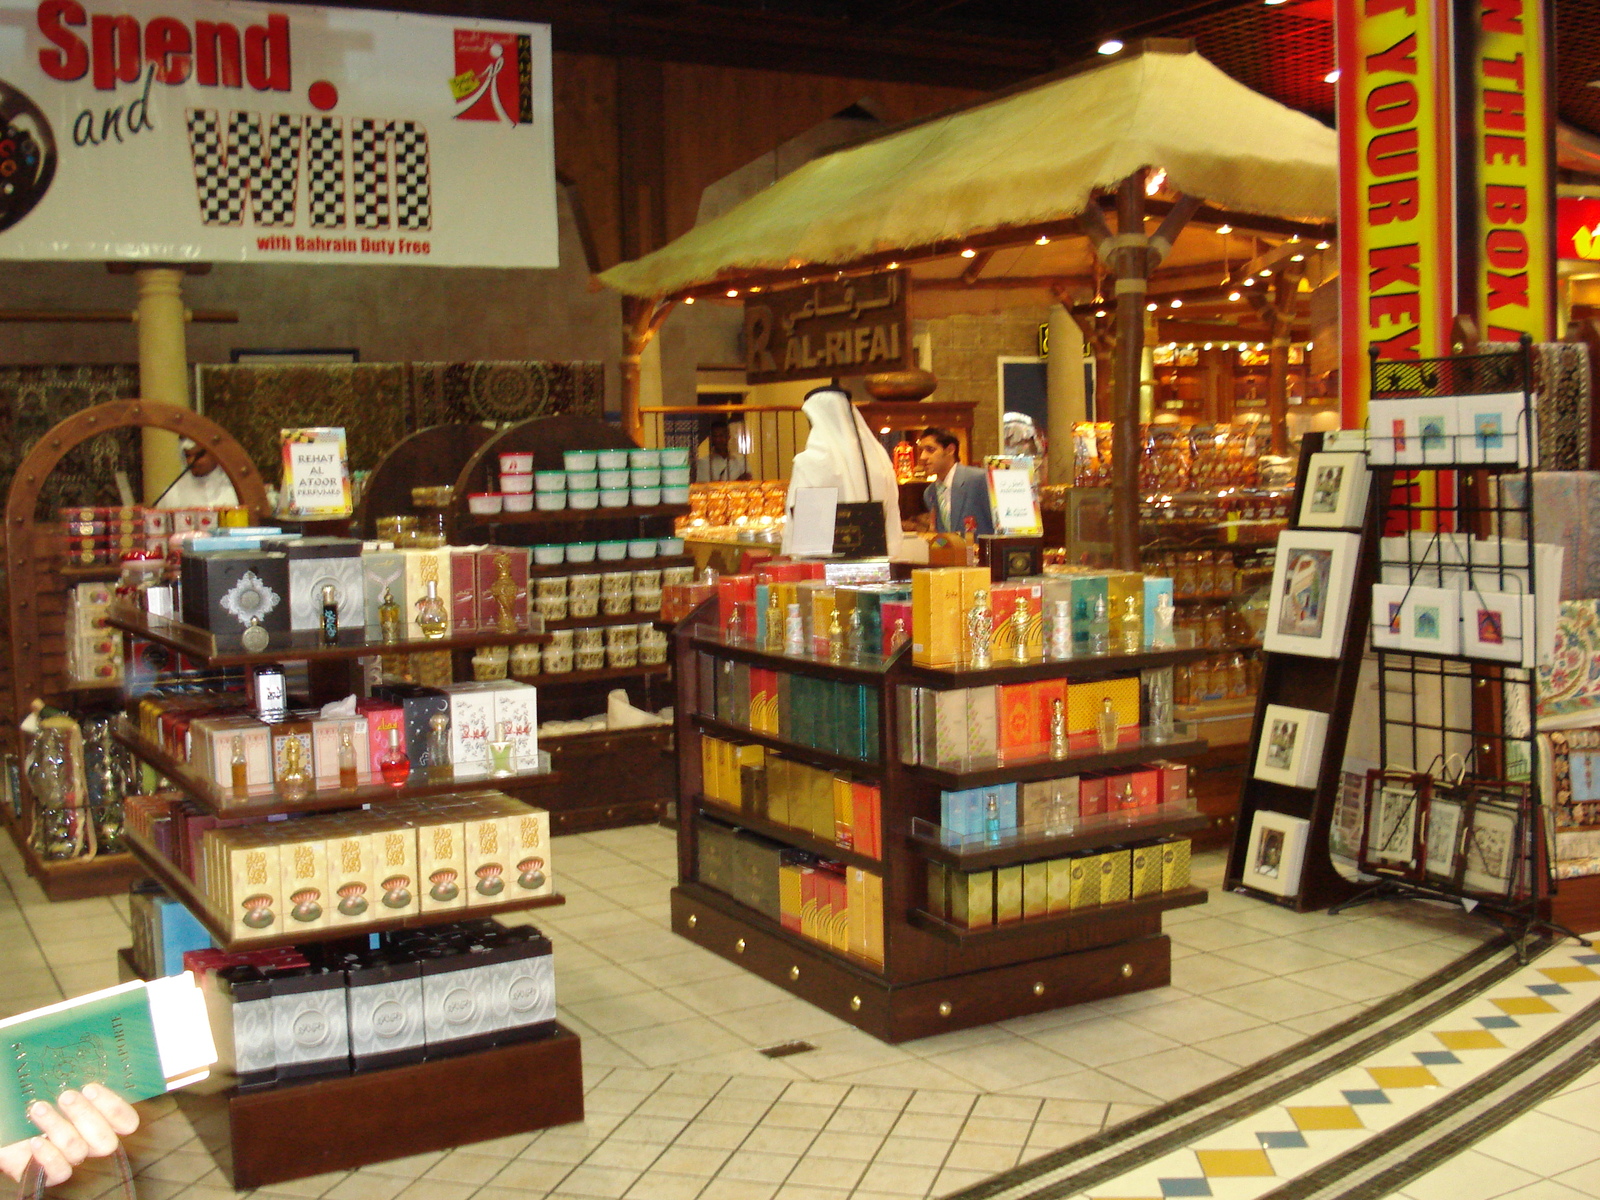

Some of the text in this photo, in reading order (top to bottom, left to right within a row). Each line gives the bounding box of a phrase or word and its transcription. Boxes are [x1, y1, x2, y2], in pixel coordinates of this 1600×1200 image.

[37, 0, 292, 91] Spend
[72, 62, 155, 146] and
[1366, 31, 1420, 226] YOUR
[1482, 52, 1526, 167] THE
[257, 235, 431, 255] with Bahrain Duty Free
[1486, 184, 1530, 312] BOX
[1369, 242, 1421, 367] KEY
[784, 321, 900, 370] AL-RIFAI
[298, 455, 333, 463] REHAT
[299, 478, 337, 486] ATOOR
[310, 466, 324, 475] AL
[111, 1012, 136, 1090] PASAPORTE
